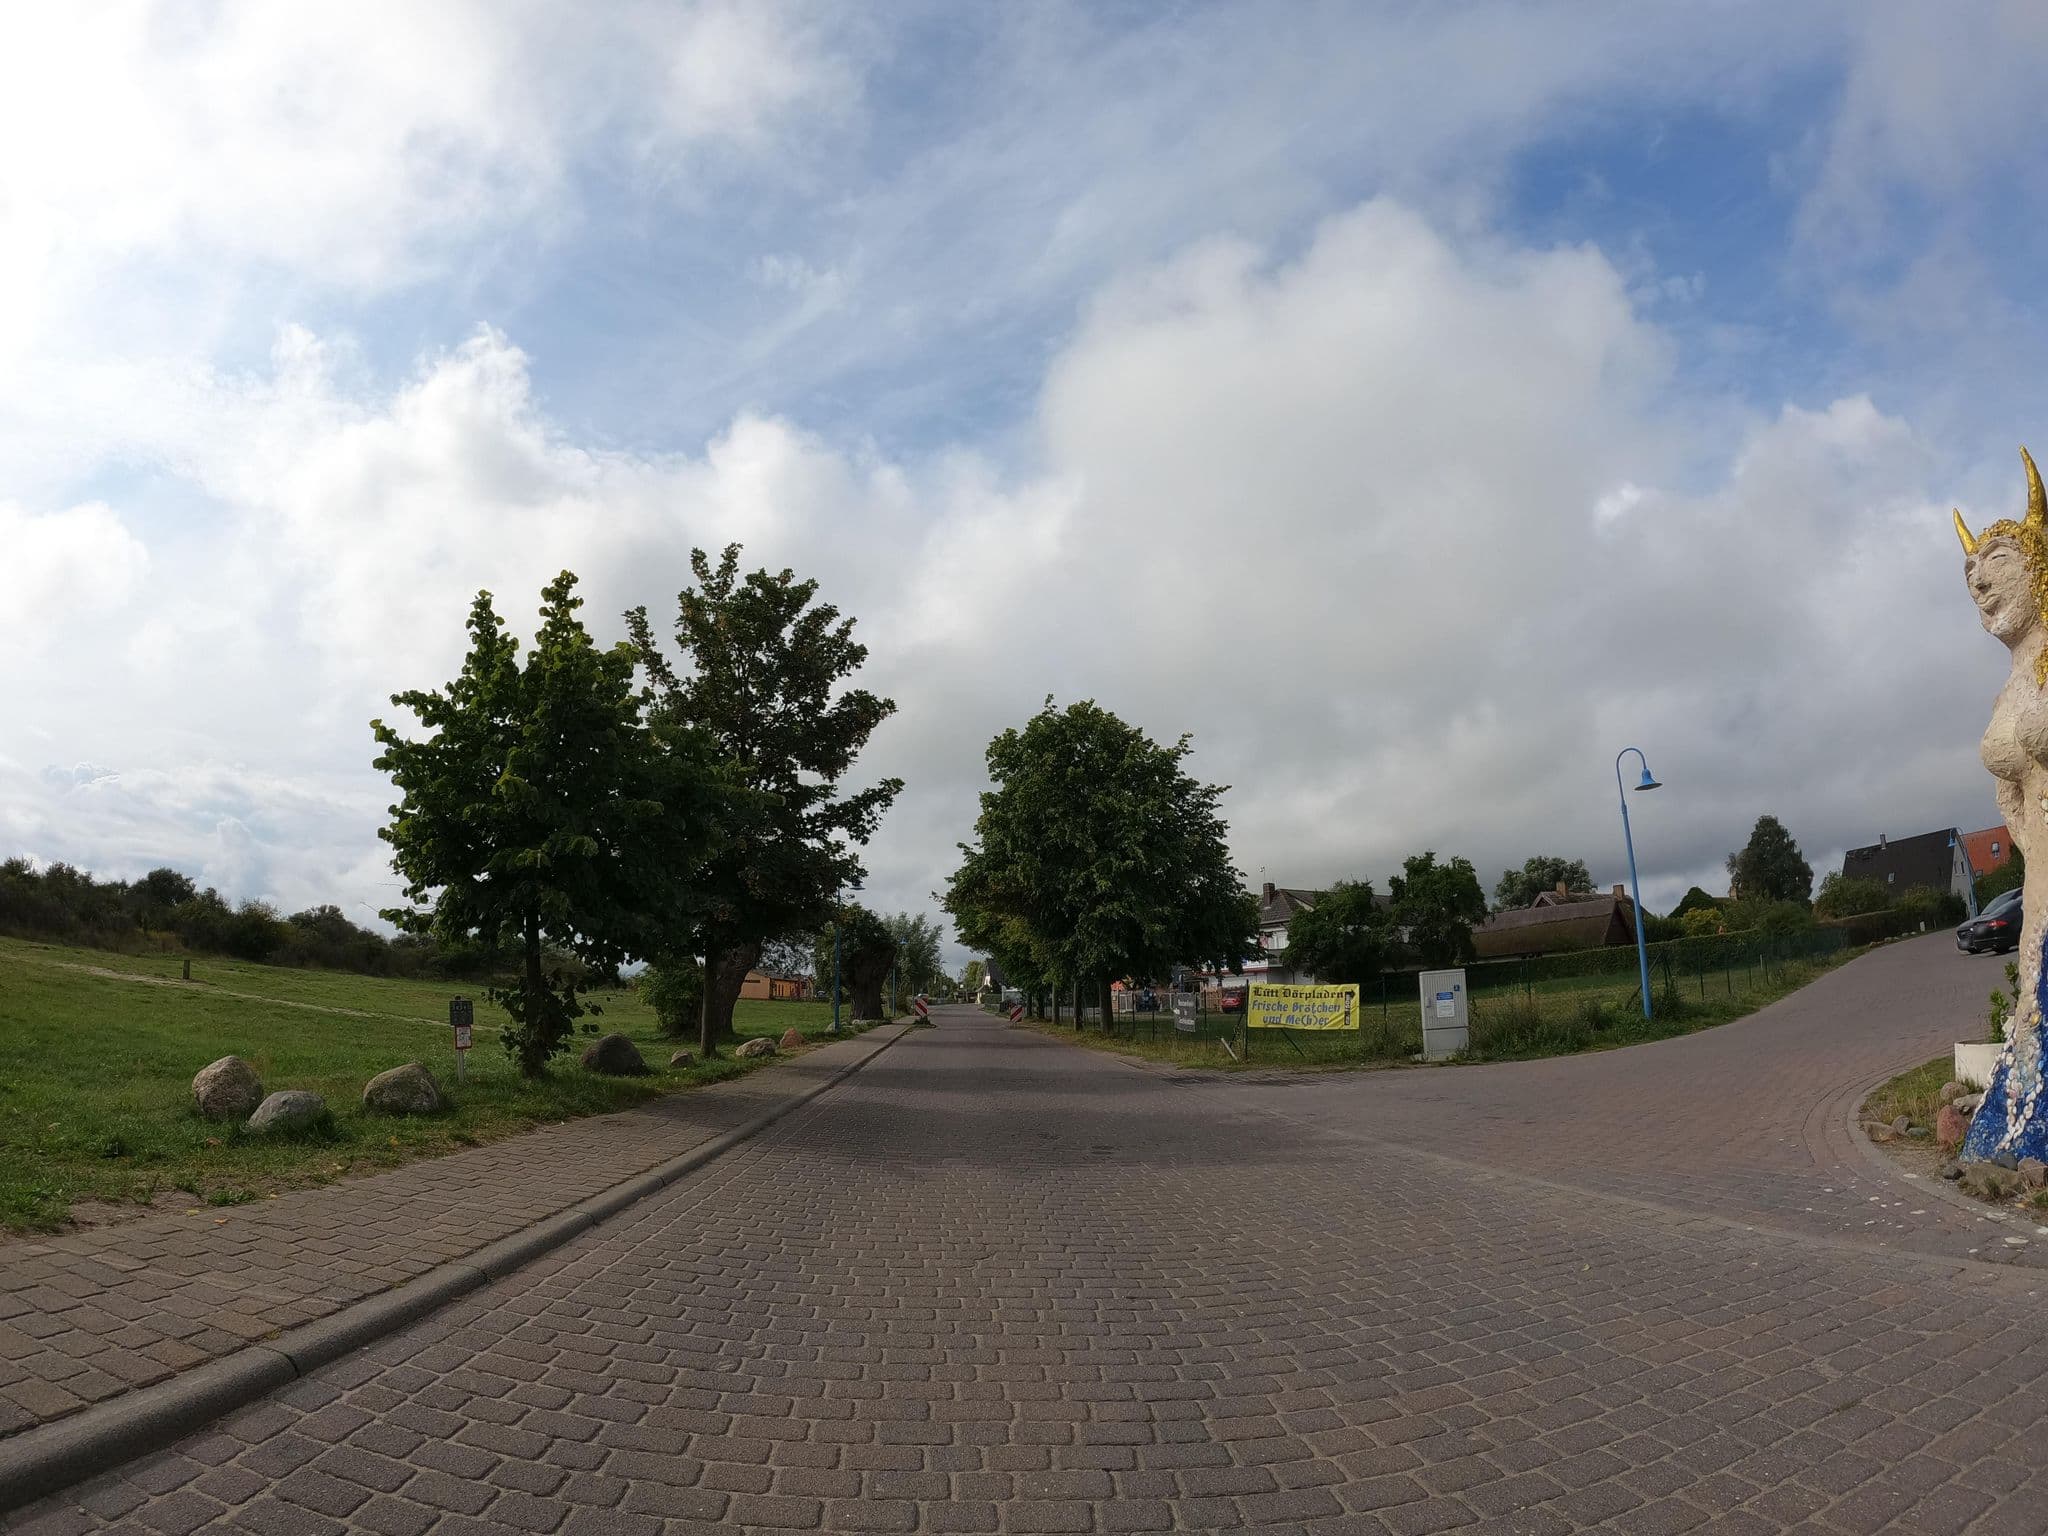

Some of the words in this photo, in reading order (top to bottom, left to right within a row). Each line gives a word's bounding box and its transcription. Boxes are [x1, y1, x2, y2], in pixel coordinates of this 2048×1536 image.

[1282, 988, 1344, 1001] Dörpladen
[1252, 999, 1289, 1012] Frische
[1292, 1002, 1341, 1014] Brötchen
[1262, 1014, 1282, 1025] und
